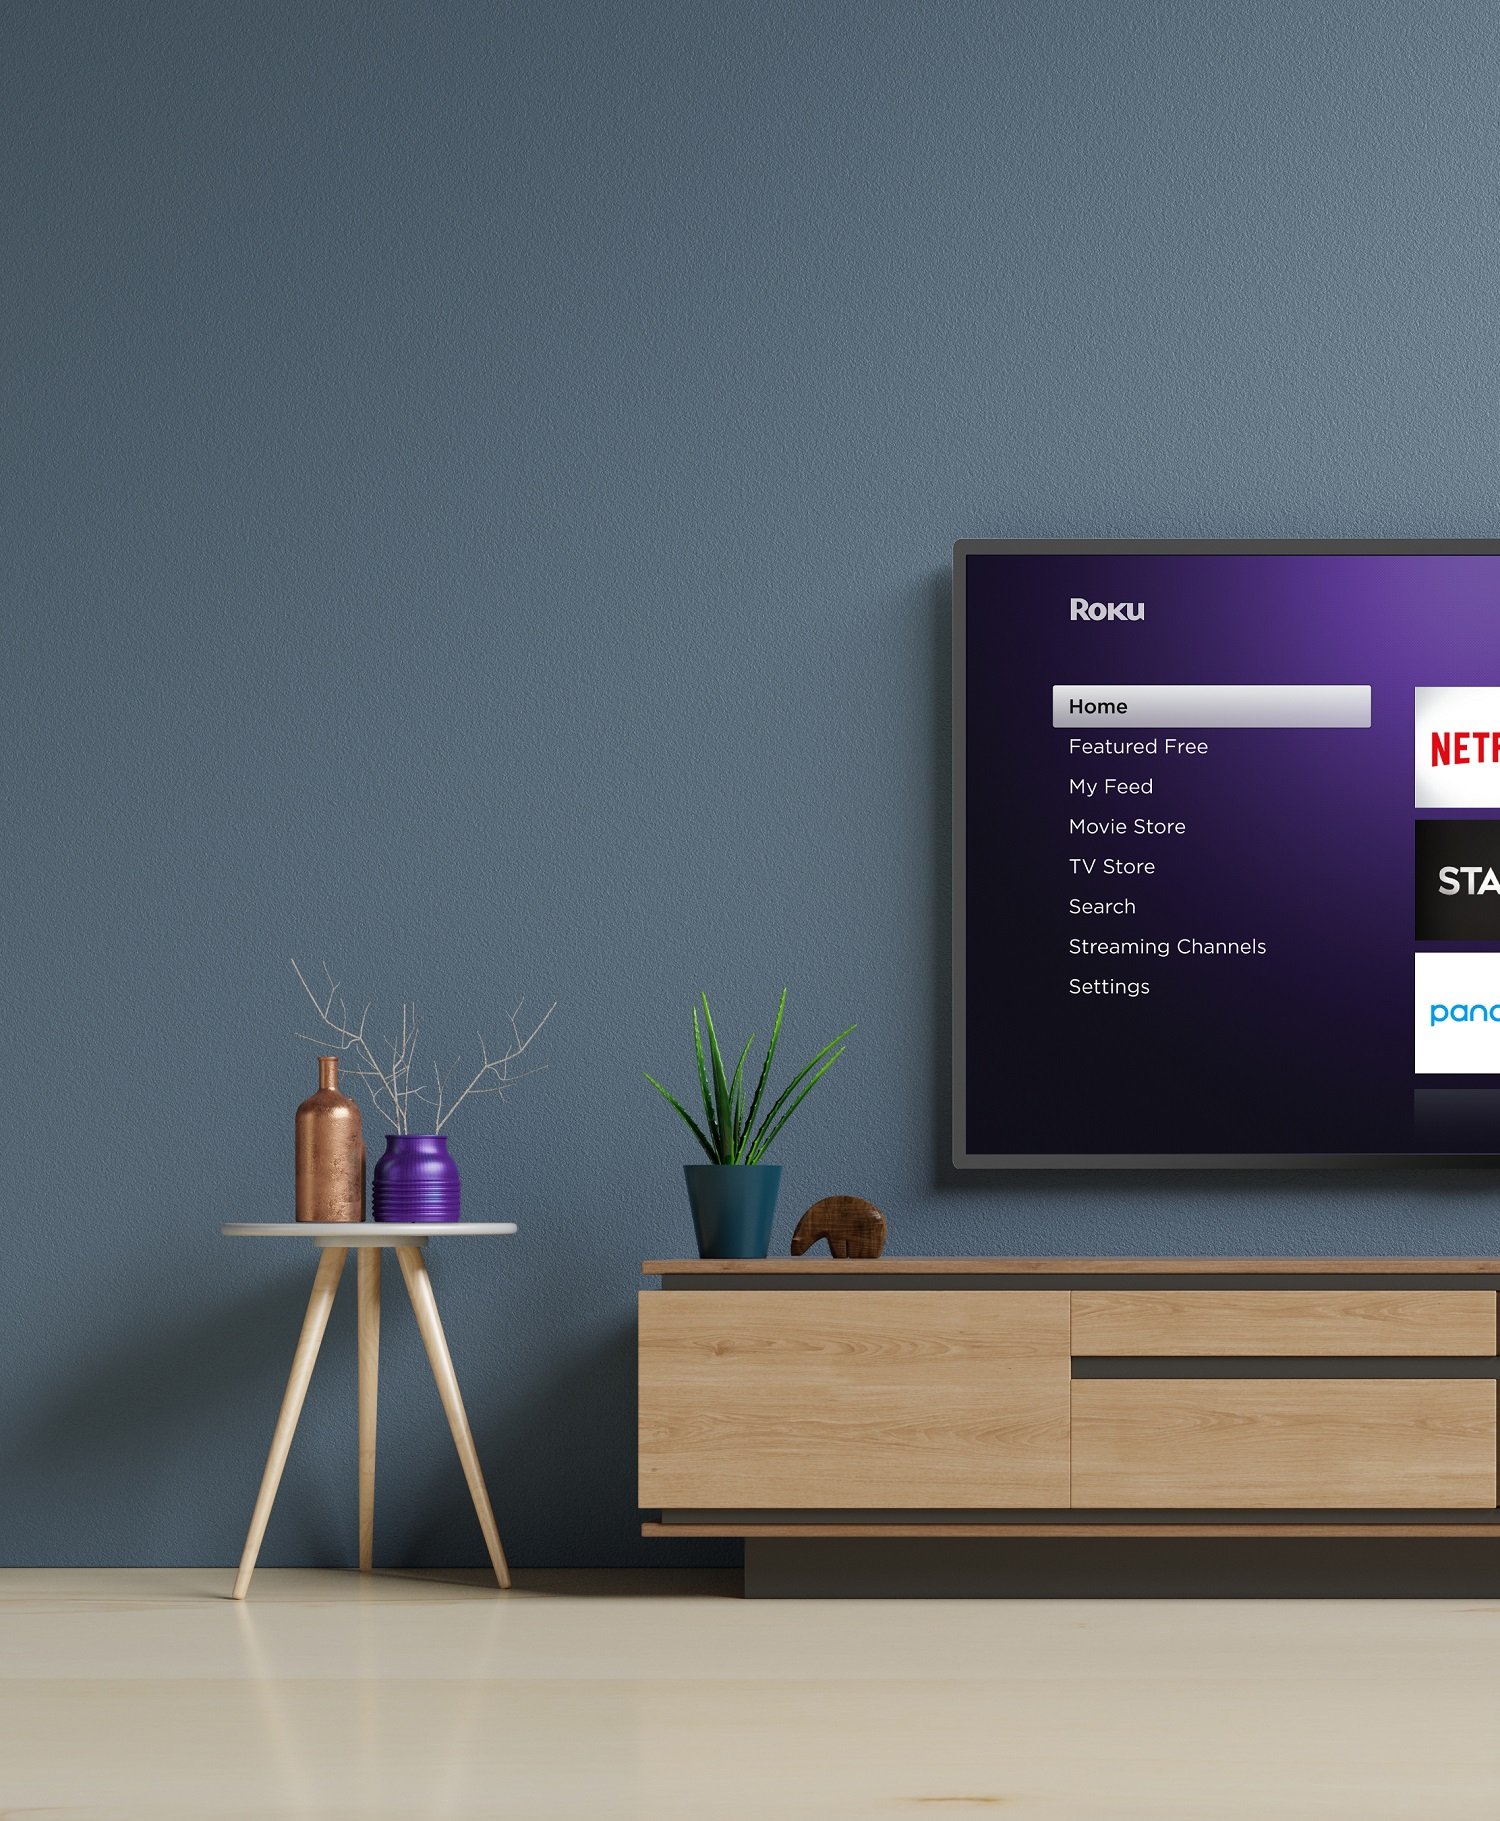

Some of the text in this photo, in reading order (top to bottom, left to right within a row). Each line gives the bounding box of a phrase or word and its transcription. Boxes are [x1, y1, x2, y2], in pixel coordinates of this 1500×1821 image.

[1069, 698, 1128, 715] Home
[1070, 738, 1209, 755] Featured Free
[1070, 777, 1153, 797] My Feed
[1070, 818, 1186, 835] Movie Store
[1069, 858, 1156, 875] TV Store
[1069, 898, 1136, 915] Search
[1069, 938, 1267, 958] Streaming Channels
[1069, 978, 1150, 998] Settings
